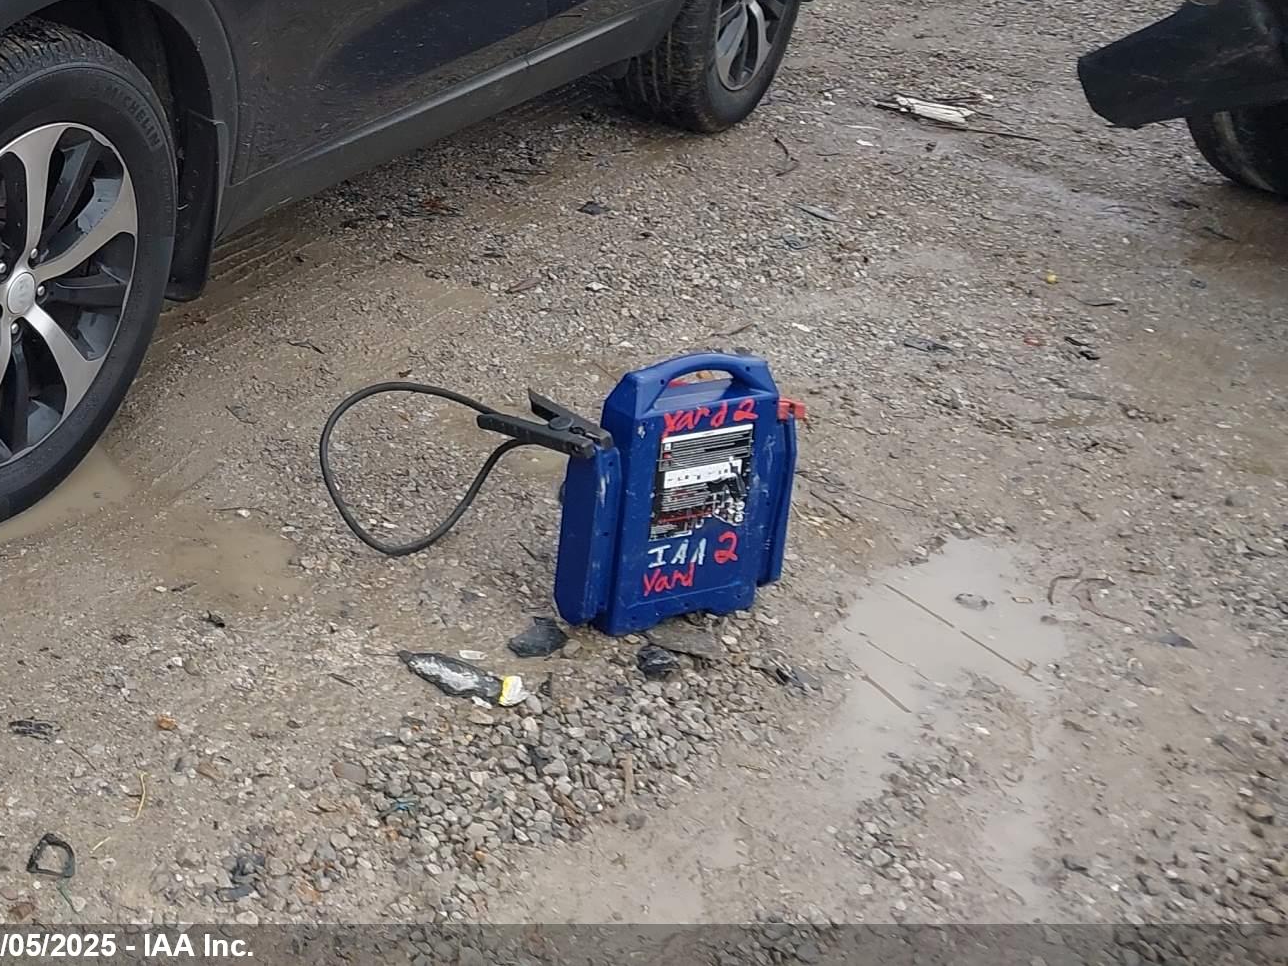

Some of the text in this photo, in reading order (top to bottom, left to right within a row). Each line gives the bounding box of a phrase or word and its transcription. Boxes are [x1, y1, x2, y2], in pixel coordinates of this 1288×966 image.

[733, 398, 759, 422] 2
[648, 531, 738, 568] IAA 2
